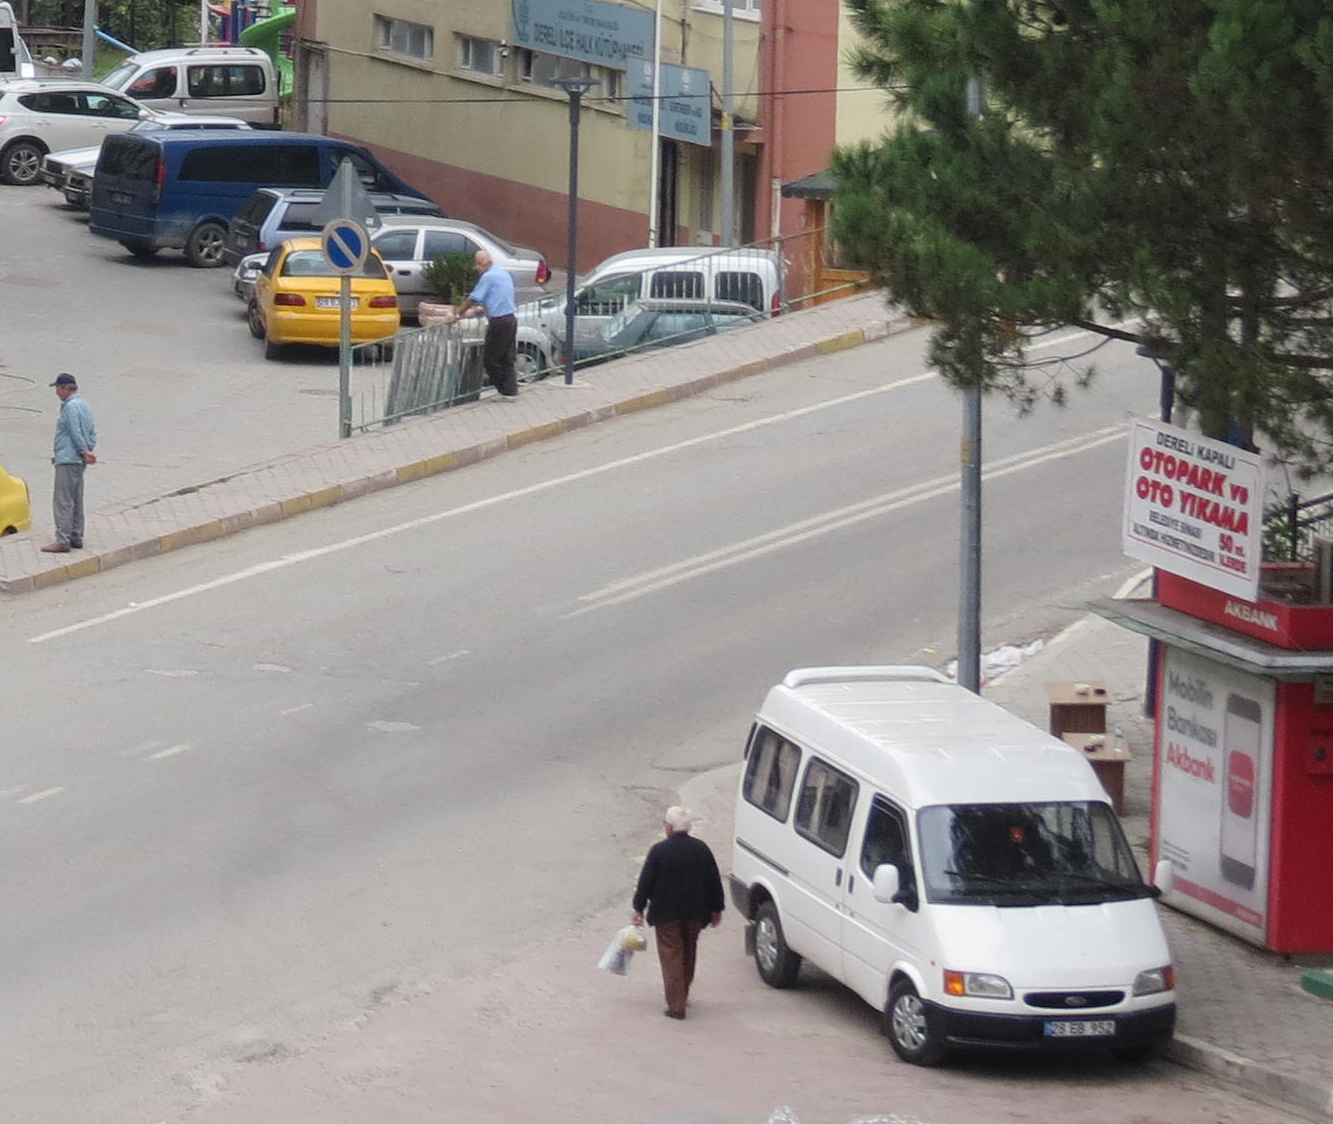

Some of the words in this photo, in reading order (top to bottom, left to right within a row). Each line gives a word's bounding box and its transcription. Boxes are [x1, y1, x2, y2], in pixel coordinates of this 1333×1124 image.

[1140, 446, 1227, 498] OTOPARK
[1196, 444, 1235, 470] KAPALI
[1136, 476, 1173, 508] OTO
[1180, 490, 1249, 536] YIKAMA
[1224, 600, 1278, 632] AKBANK
[1166, 741, 1215, 784] Akbank
